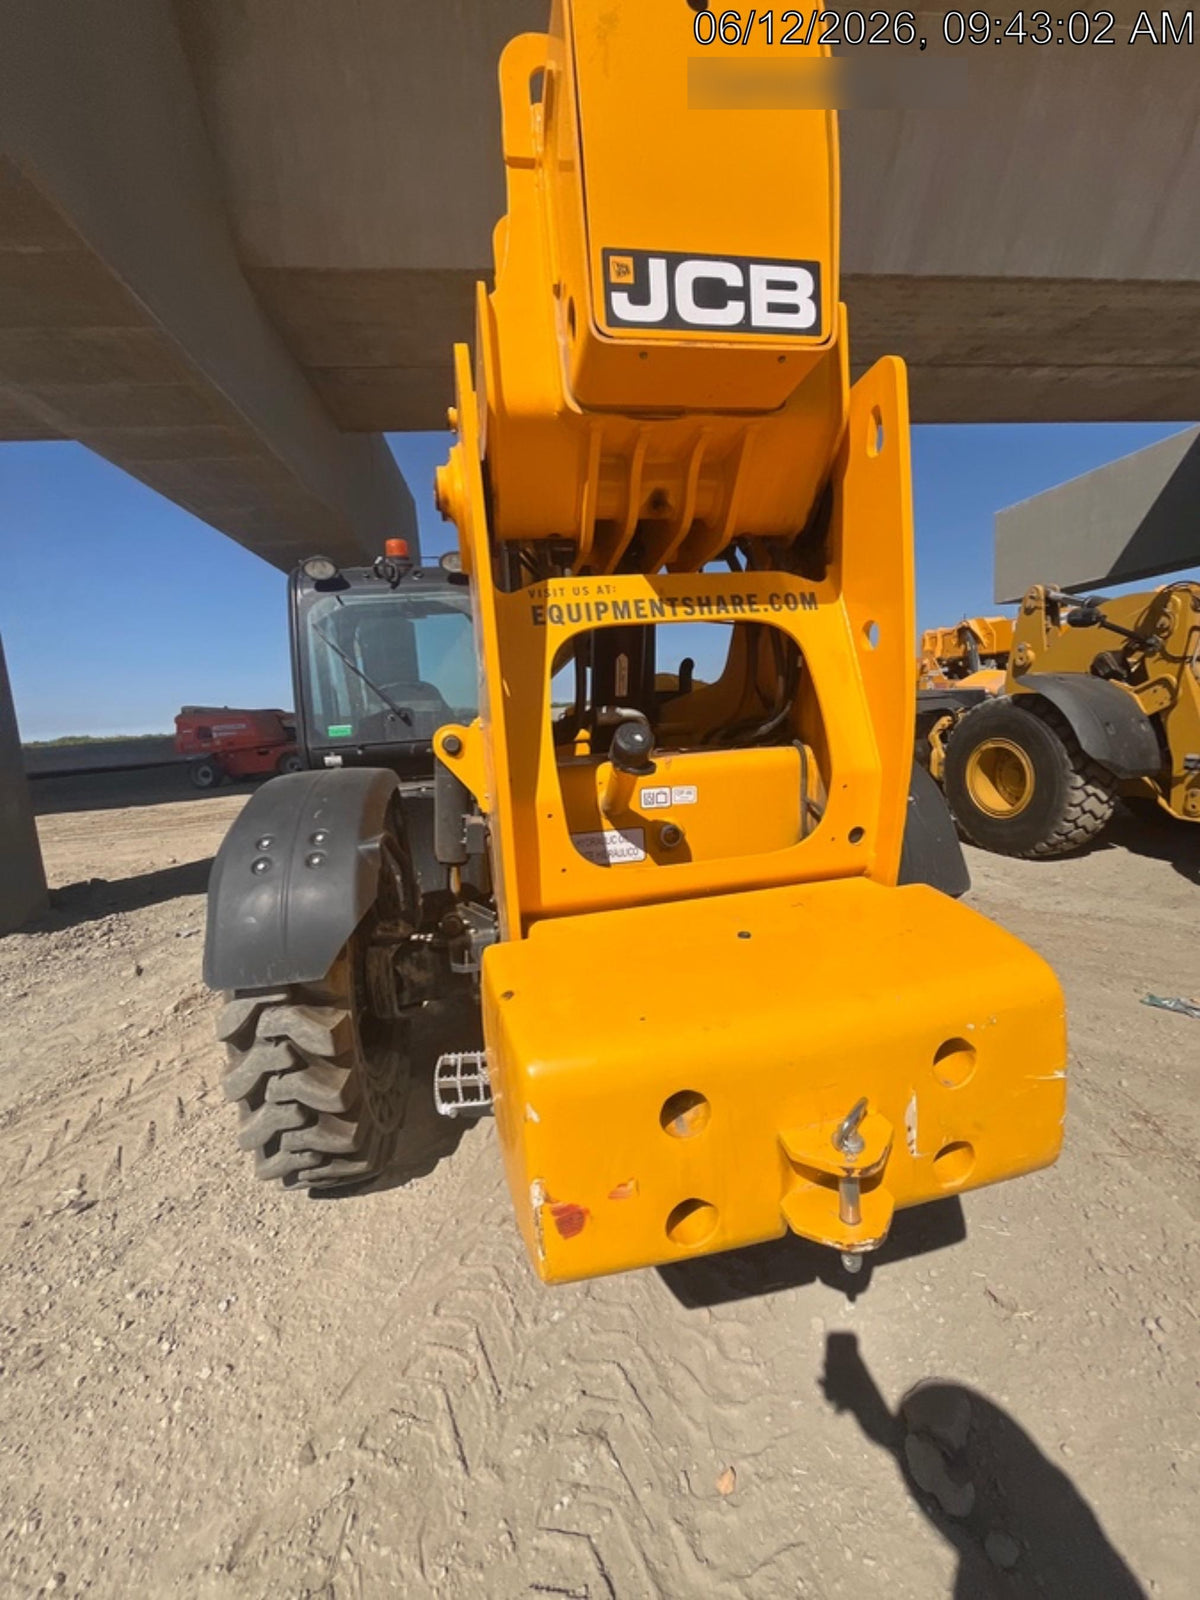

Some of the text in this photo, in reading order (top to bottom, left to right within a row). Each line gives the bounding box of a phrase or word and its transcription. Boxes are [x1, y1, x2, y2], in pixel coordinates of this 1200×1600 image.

[610, 257, 817, 329] JCB
[528, 584, 617, 599] VISIT US AT:
[531, 591, 818, 626] EQUIPMENTSHARE.COM
